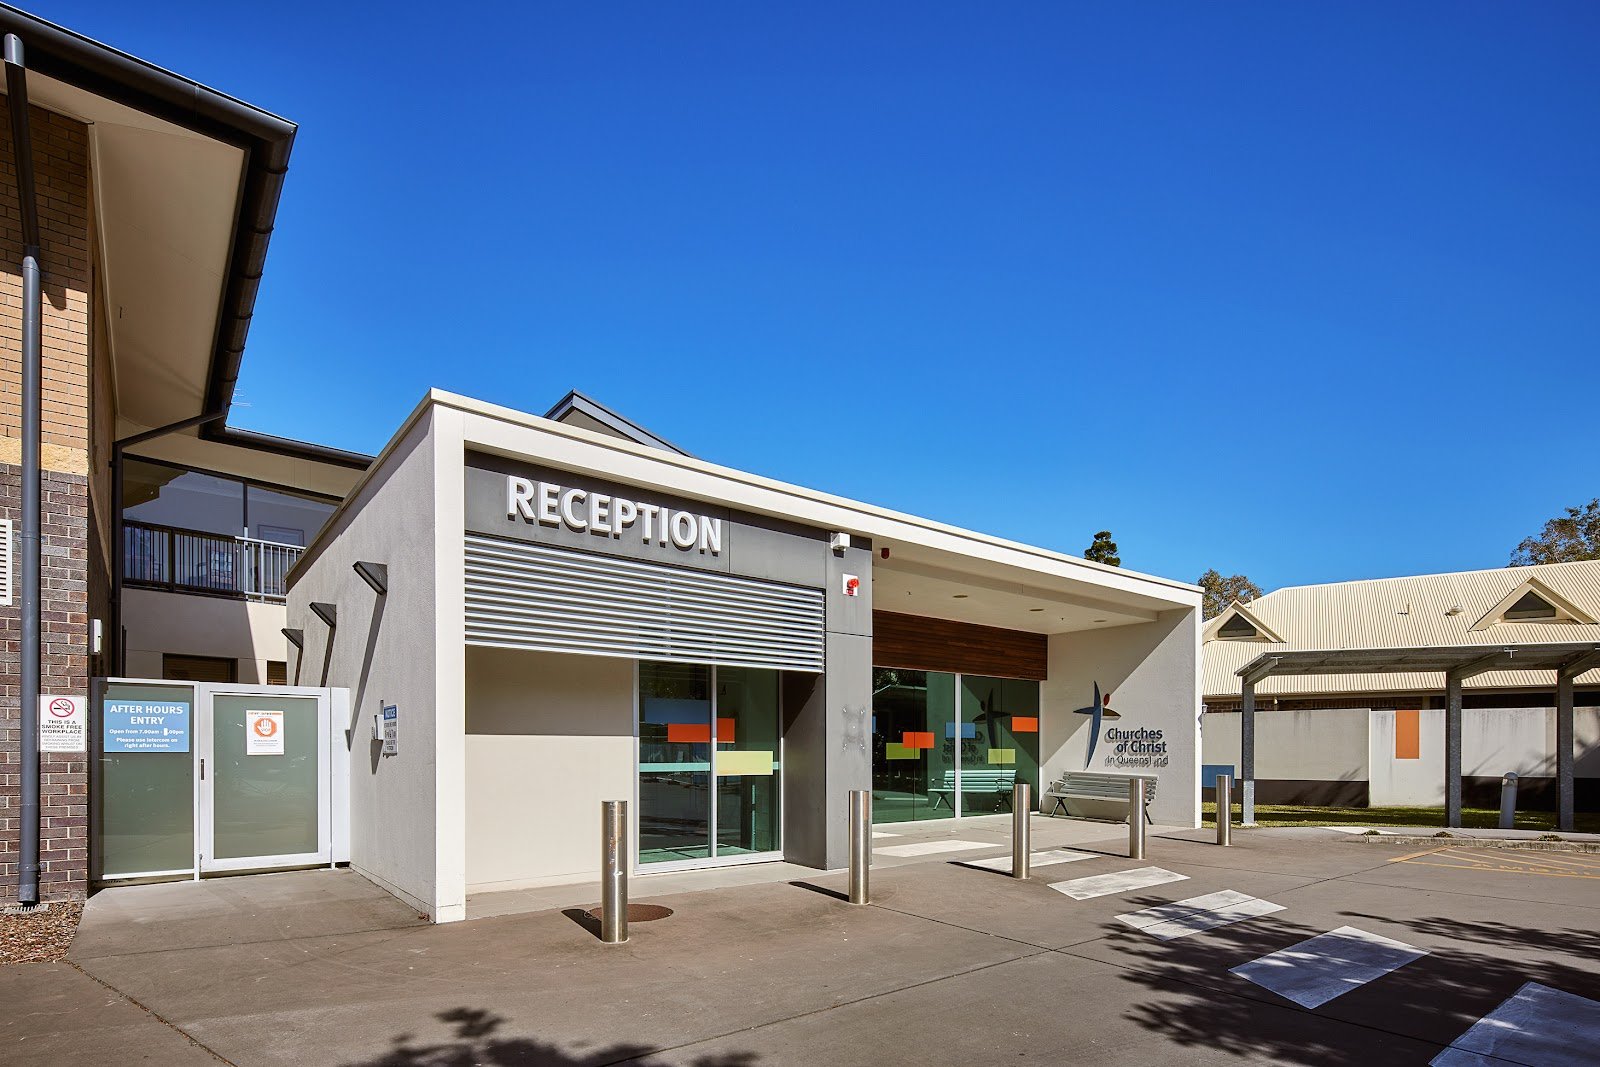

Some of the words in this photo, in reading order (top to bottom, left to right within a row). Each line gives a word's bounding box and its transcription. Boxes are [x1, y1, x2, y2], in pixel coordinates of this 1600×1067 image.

[506, 475, 722, 552] RECEPTION
[110, 705, 142, 713] AFTER
[146, 706, 183, 714] HOURS
[384, 708, 396, 719] NOTICE
[130, 716, 165, 725] ENTRY
[163, 728, 184, 736] .00pm
[1107, 726, 1163, 740] Churches
[1116, 740, 1129, 753] of
[1130, 740, 1167, 753] Christ
[1117, 755, 1169, 766] Queenslnd
